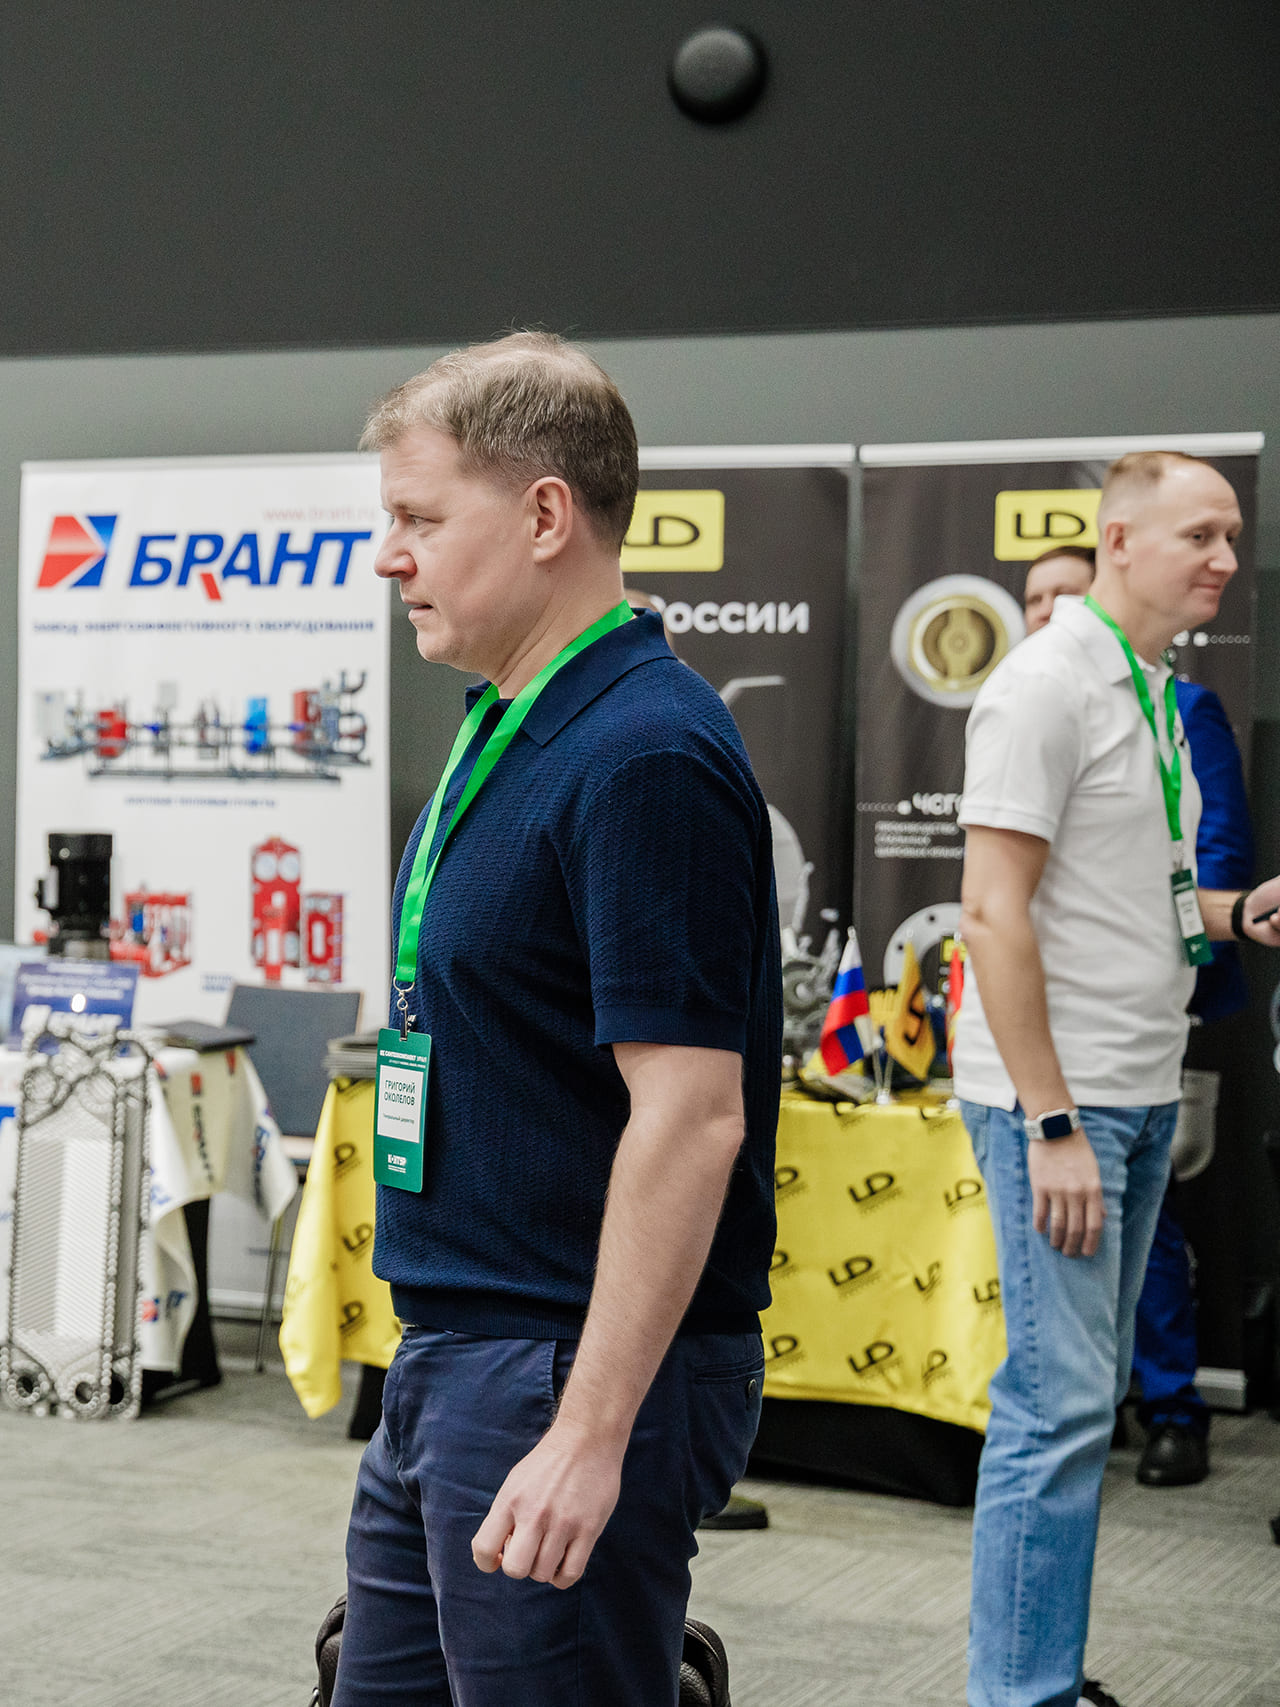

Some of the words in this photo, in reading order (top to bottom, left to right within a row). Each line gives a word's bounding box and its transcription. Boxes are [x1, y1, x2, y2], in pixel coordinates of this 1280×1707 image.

[624, 516, 700, 547] D
[1016, 512, 1086, 539] LD
[128, 530, 372, 602] БРАНТ
[384, 1079, 416, 1094] ГРИГОРИЙ
